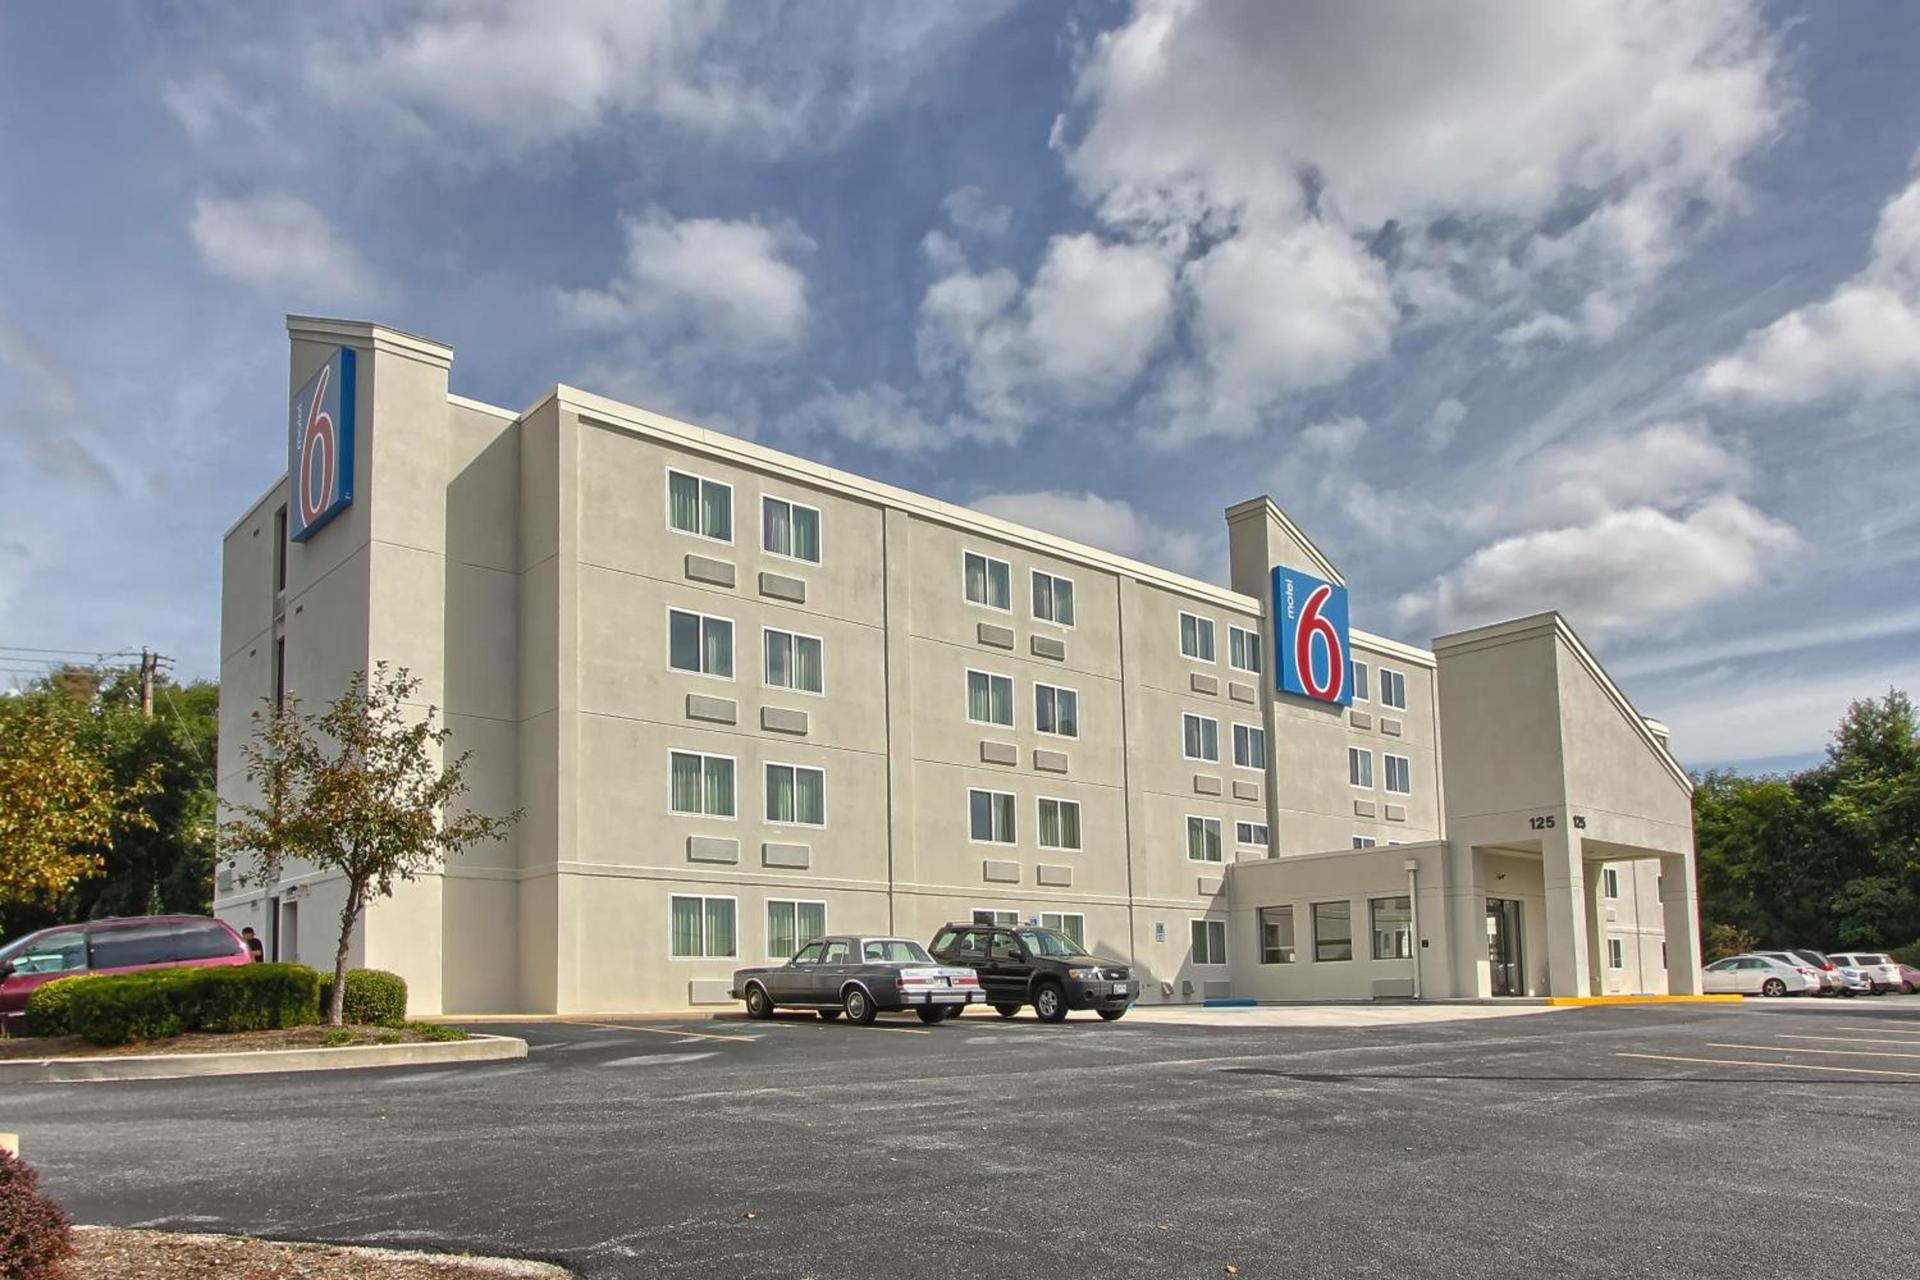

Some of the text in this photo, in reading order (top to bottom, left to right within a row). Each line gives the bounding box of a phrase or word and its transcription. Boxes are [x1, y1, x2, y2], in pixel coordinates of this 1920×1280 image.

[300, 364, 335, 527] 6
[1285, 578, 1343, 702] motel 6
[1529, 815, 1555, 829] 125
[1573, 815, 1586, 829] 125
